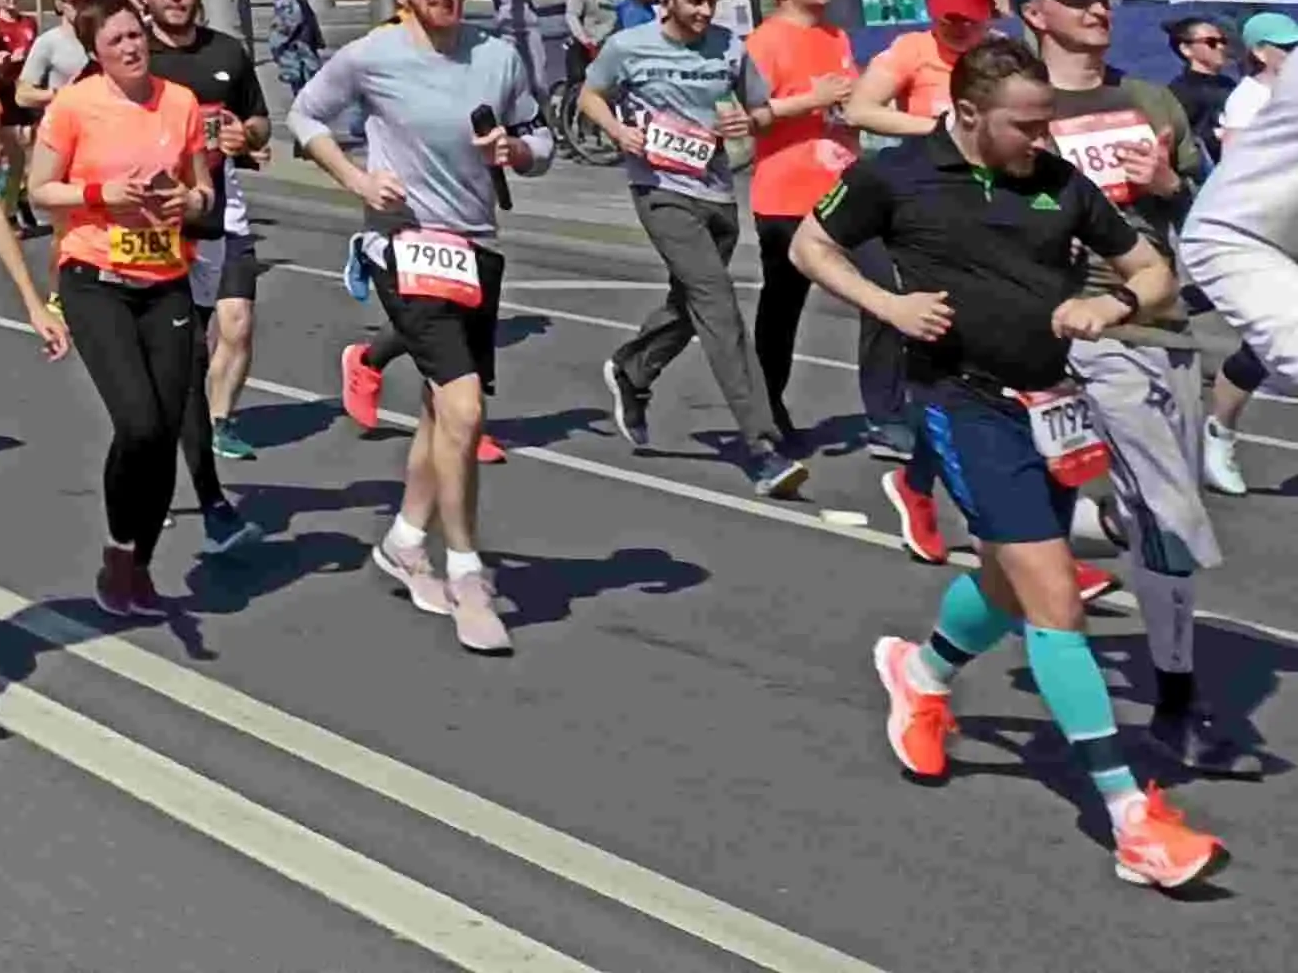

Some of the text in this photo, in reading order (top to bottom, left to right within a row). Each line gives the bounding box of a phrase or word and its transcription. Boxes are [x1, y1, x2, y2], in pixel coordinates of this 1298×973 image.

[652, 128, 709, 162] 17348
[406, 243, 468, 273] 7902
[1041, 398, 1095, 442] 7792
